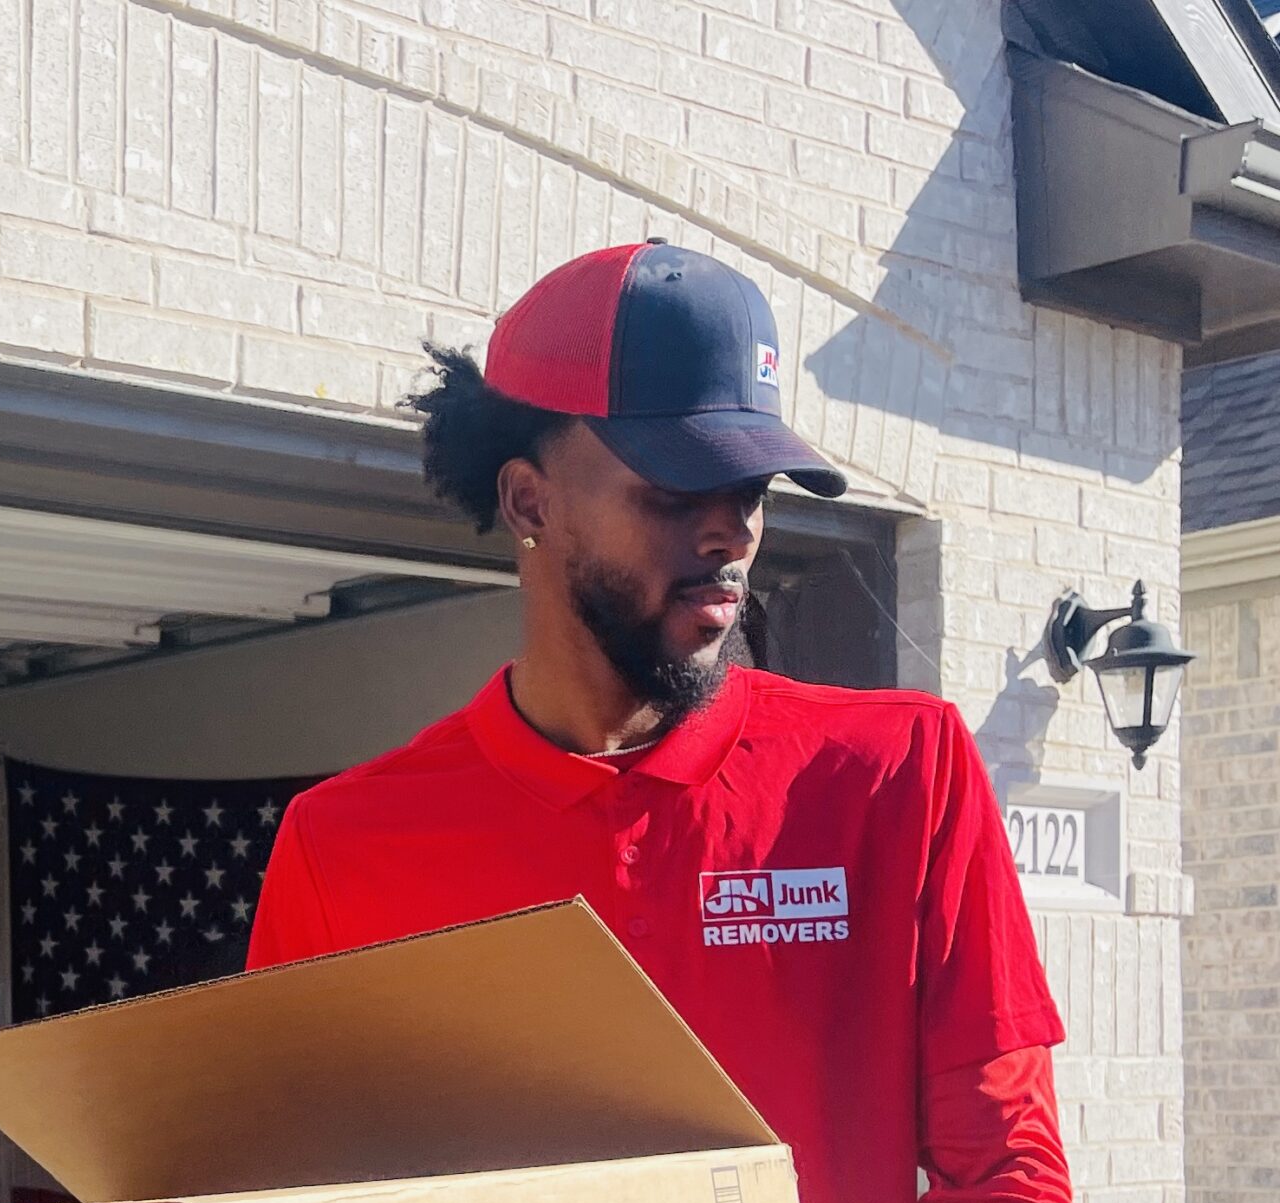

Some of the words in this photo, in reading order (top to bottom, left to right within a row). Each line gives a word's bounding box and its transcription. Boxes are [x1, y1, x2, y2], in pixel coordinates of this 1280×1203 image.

[1008, 809, 1079, 876] 2122
[778, 880, 841, 906] Junk
[703, 920, 850, 946] REMOVERS
